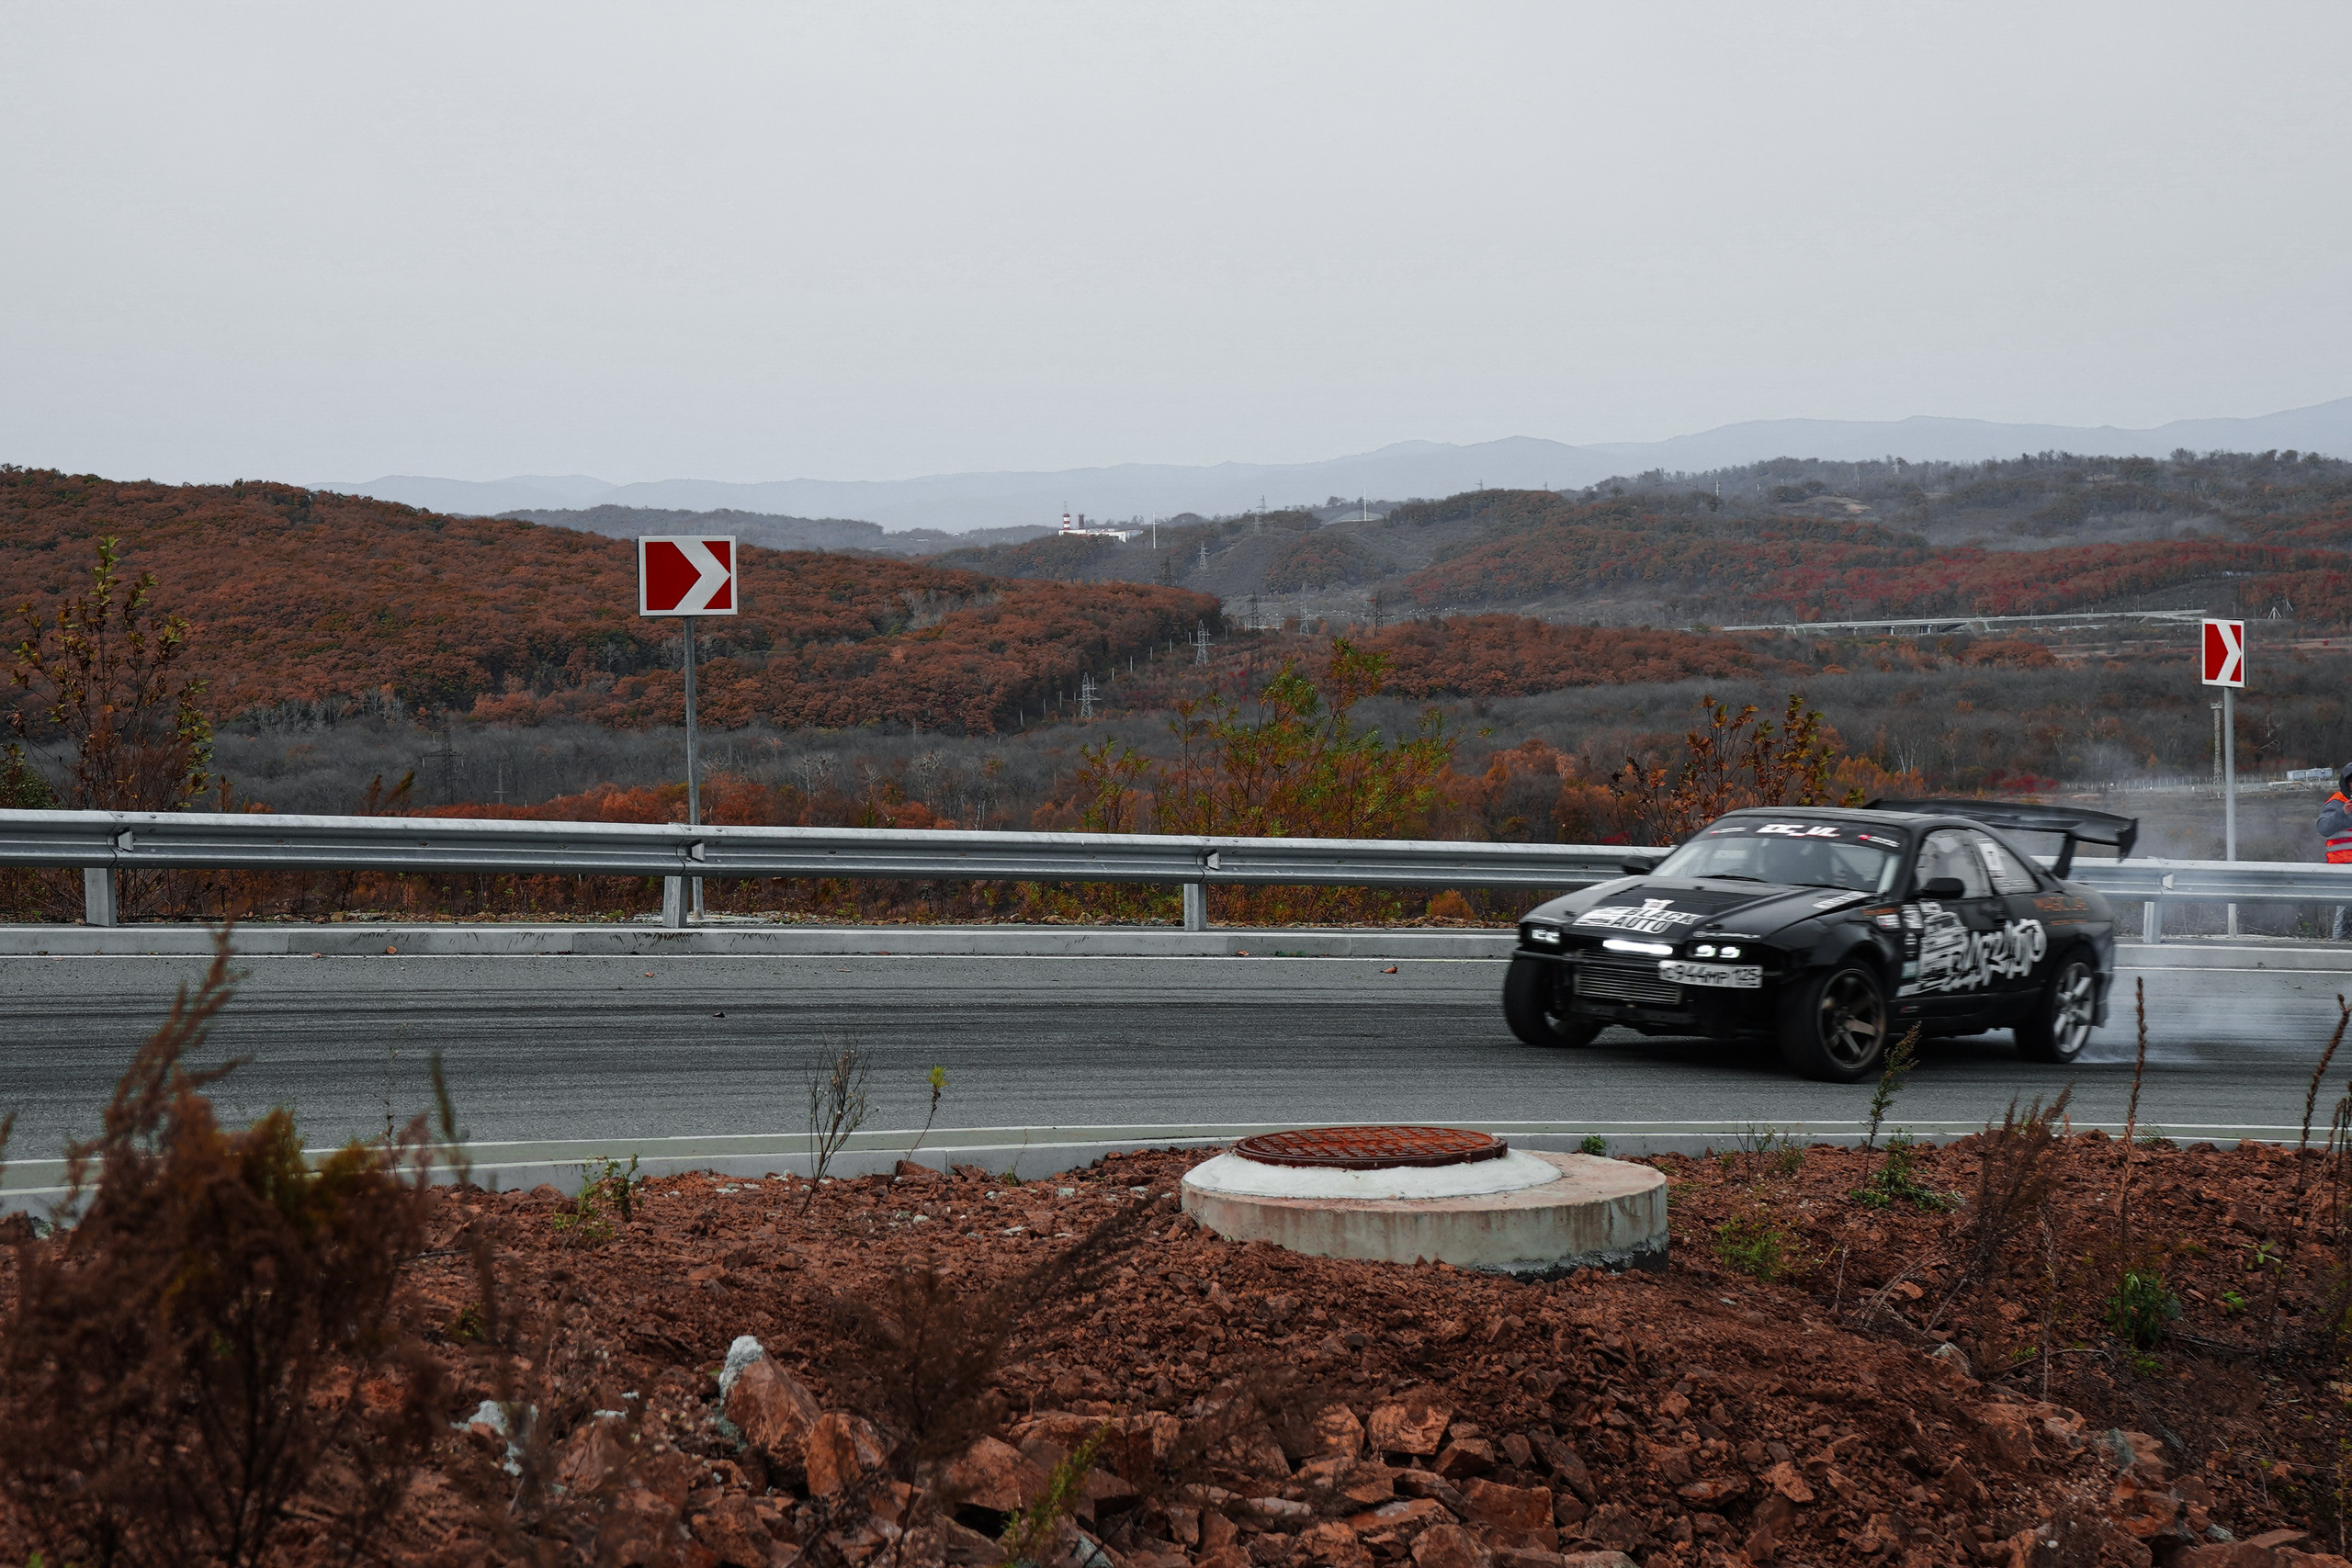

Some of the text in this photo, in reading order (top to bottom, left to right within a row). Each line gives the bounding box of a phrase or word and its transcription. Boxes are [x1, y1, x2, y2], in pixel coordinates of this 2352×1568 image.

[1611, 916, 1671, 932] AUTO
[1623, 908, 1697, 925] BLACK
[1731, 968, 1763, 981] 125
